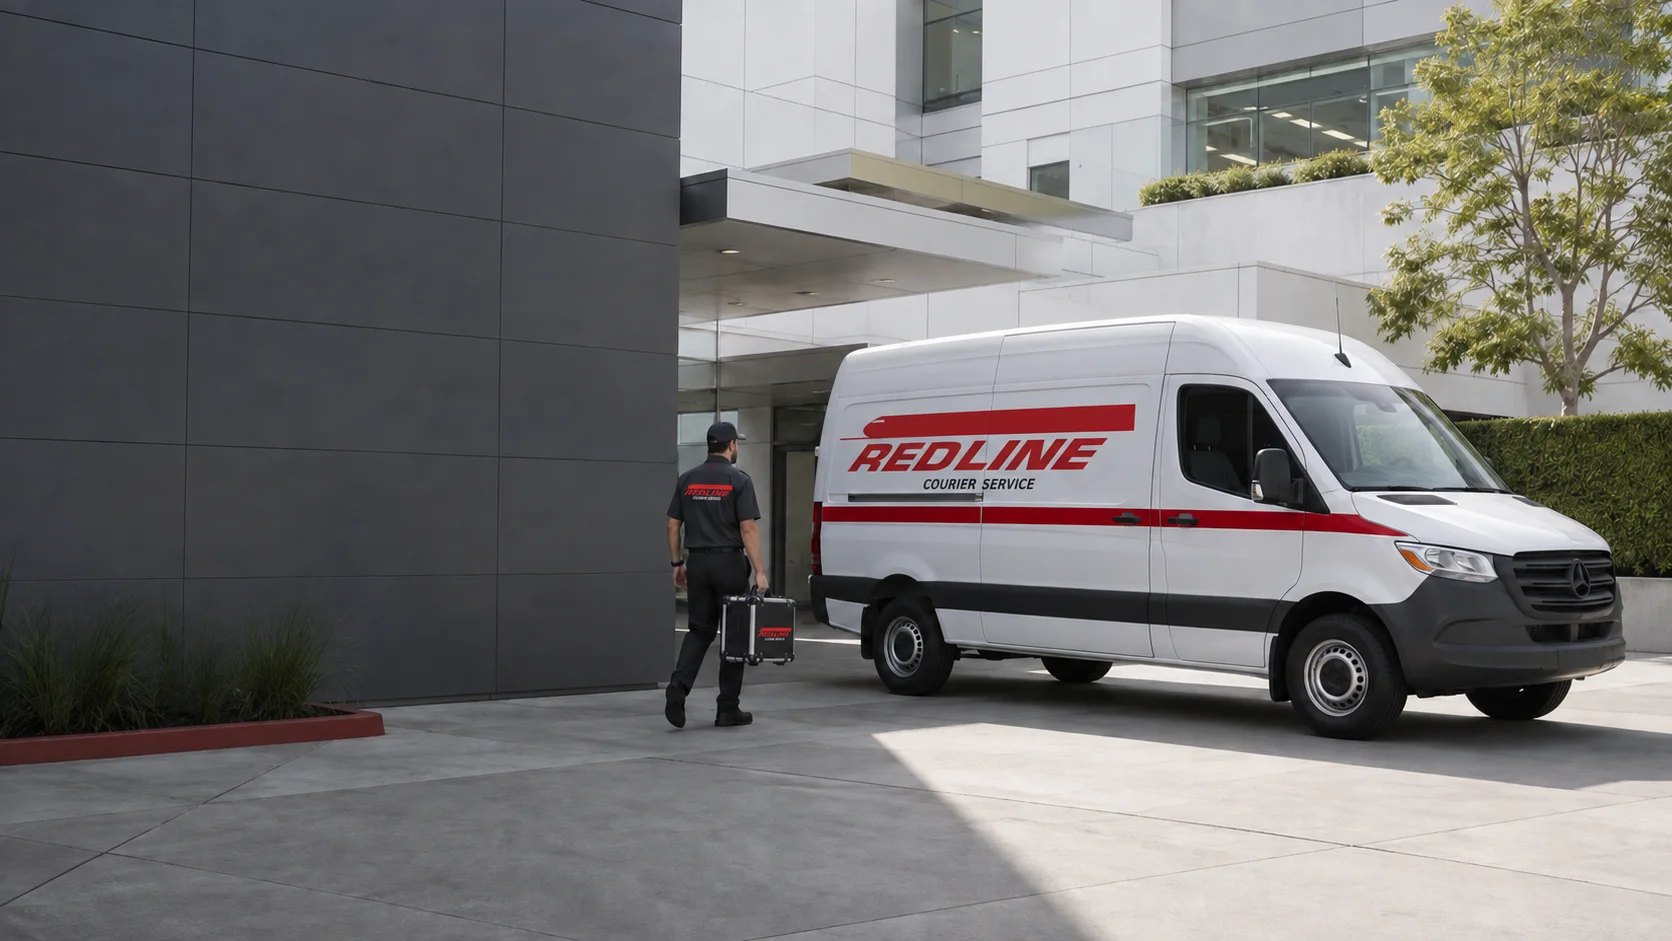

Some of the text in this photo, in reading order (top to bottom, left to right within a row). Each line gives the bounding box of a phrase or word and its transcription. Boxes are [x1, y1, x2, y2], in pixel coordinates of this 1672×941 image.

[847, 437, 1108, 472] REDLINE
[923, 478, 1036, 490] COURIER SERVICE
